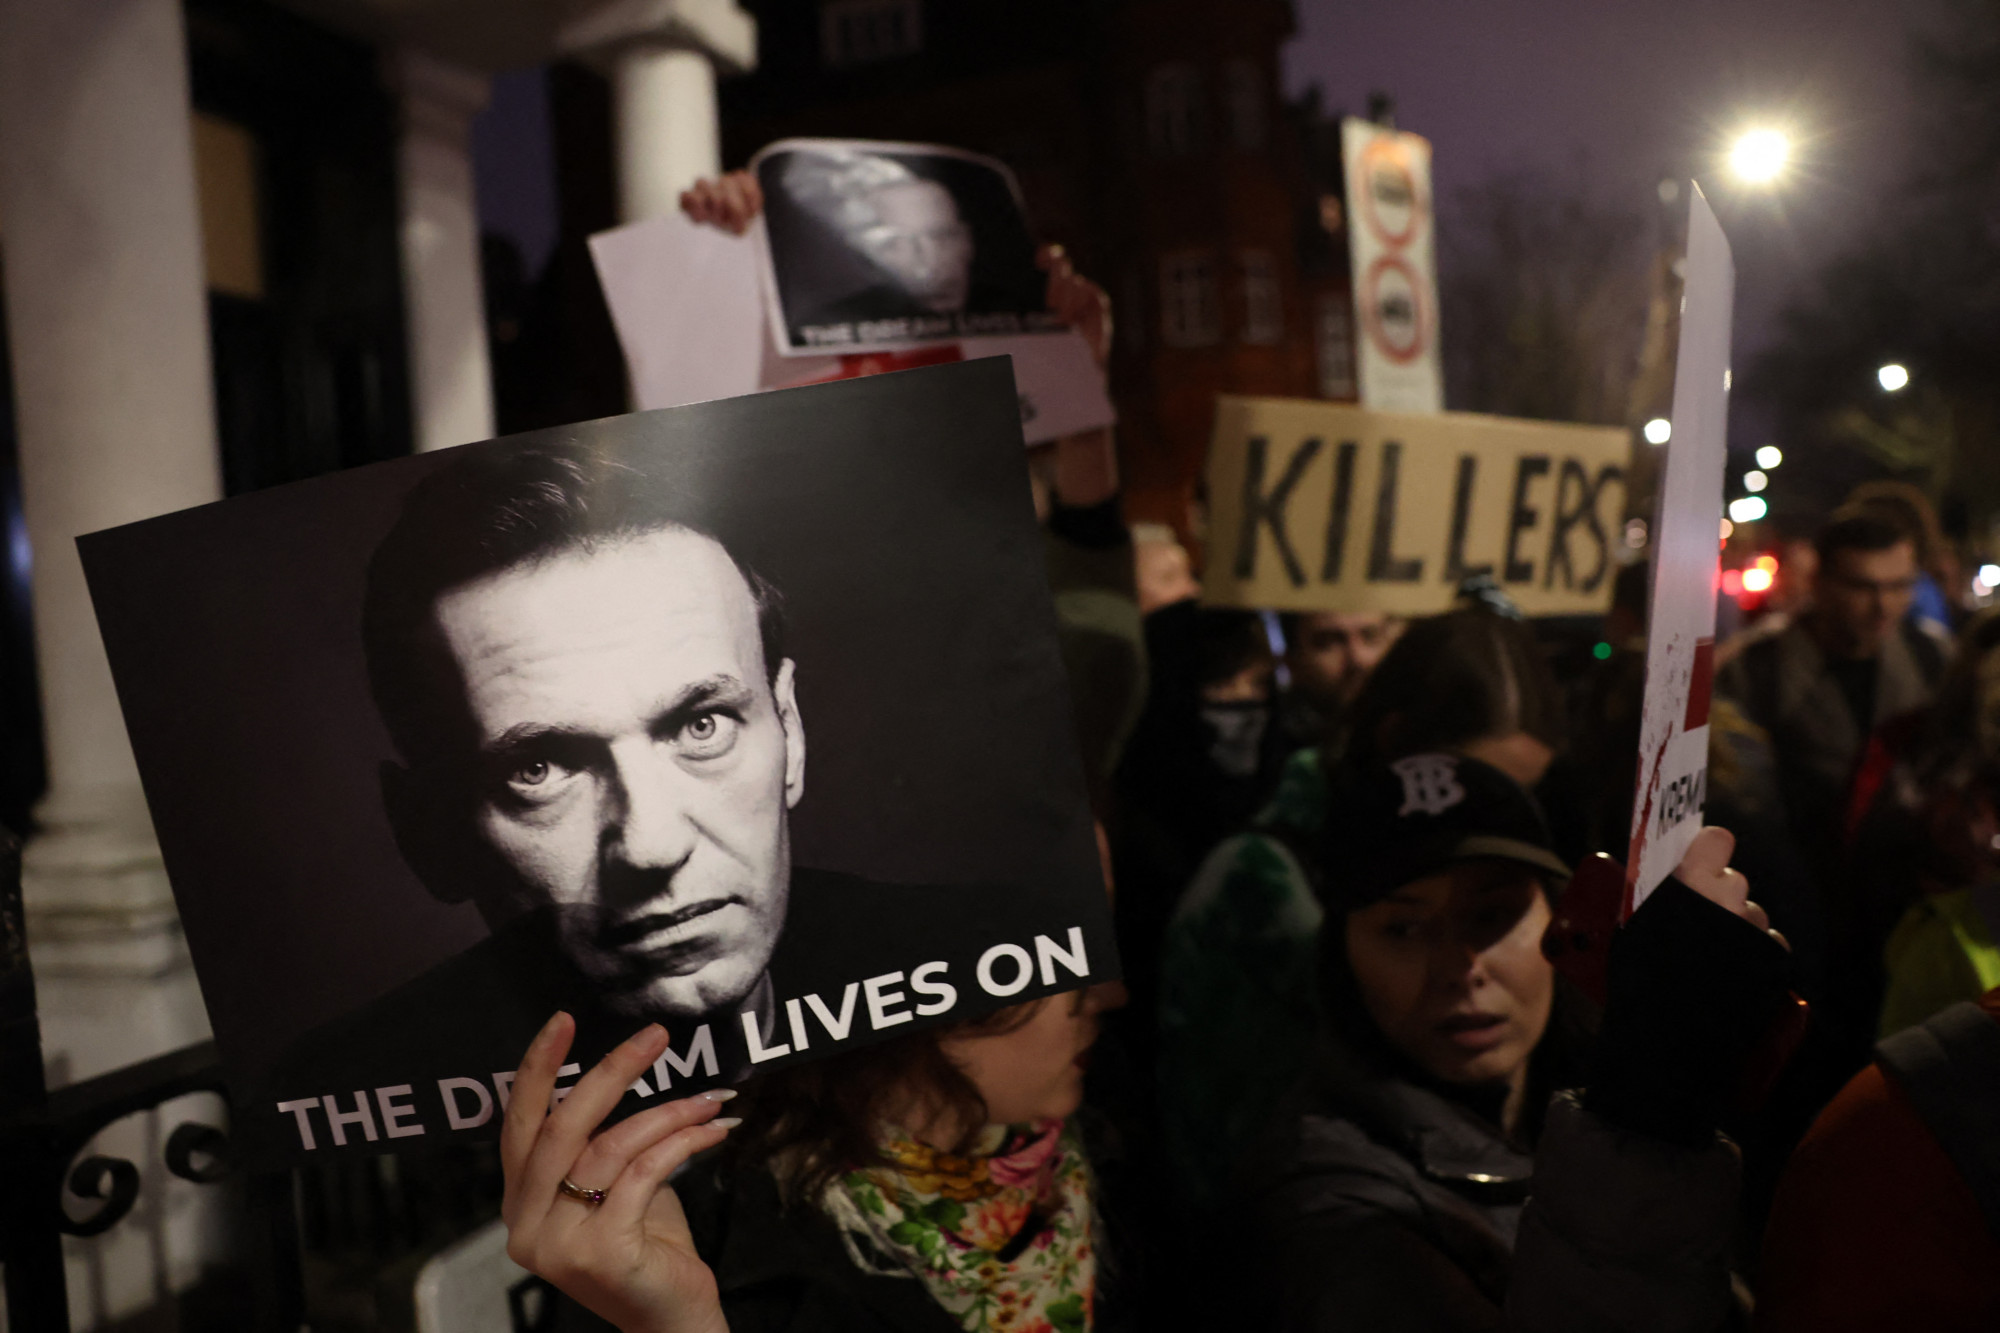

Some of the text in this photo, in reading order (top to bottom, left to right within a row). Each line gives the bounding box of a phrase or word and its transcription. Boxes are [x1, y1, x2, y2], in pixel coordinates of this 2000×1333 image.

[801, 322, 852, 346] THE
[1233, 435, 1626, 594] KILLERS
[277, 926, 1091, 1150] THE DEM LIVES ON
